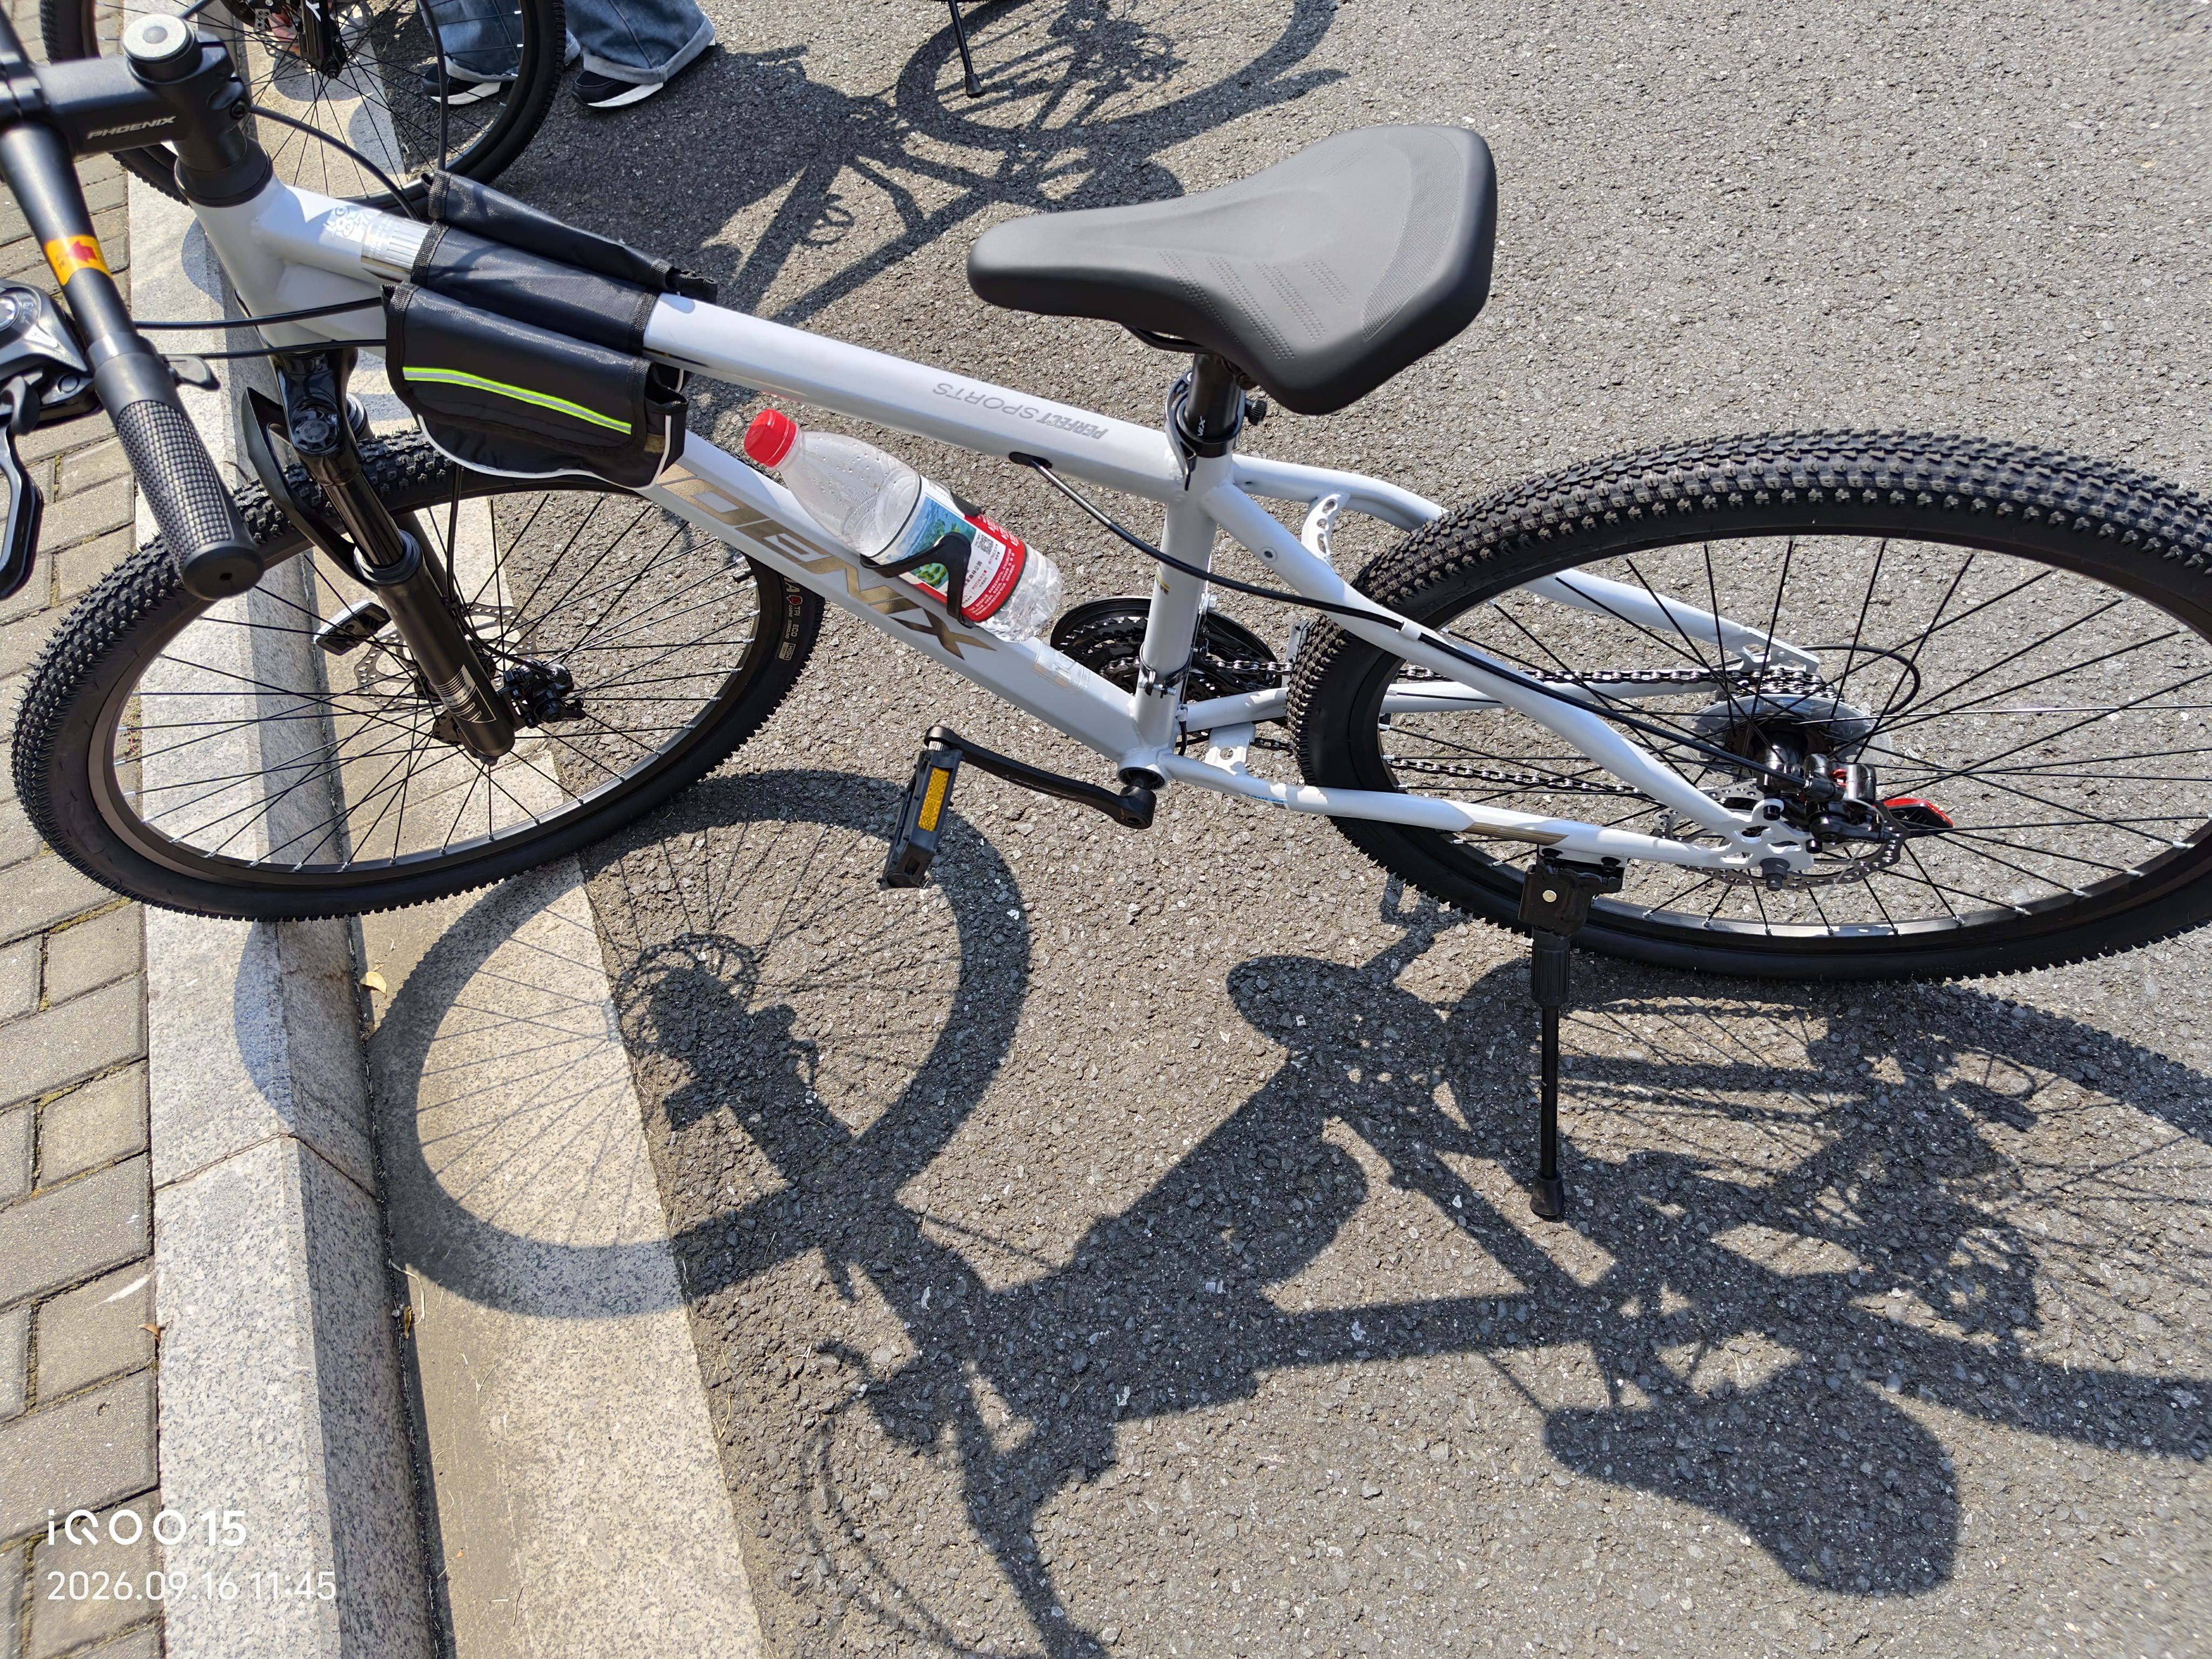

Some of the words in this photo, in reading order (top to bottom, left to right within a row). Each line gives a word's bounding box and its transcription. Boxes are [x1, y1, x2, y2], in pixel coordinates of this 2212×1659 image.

[86, 116, 177, 140] PHOENIX
[933, 382, 1039, 419] SPORTS
[1036, 412, 1109, 440] PERFECT
[656, 463, 997, 660] OENIX
[791, 624, 799, 637] ECO
[784, 645, 794, 659] HIGH
